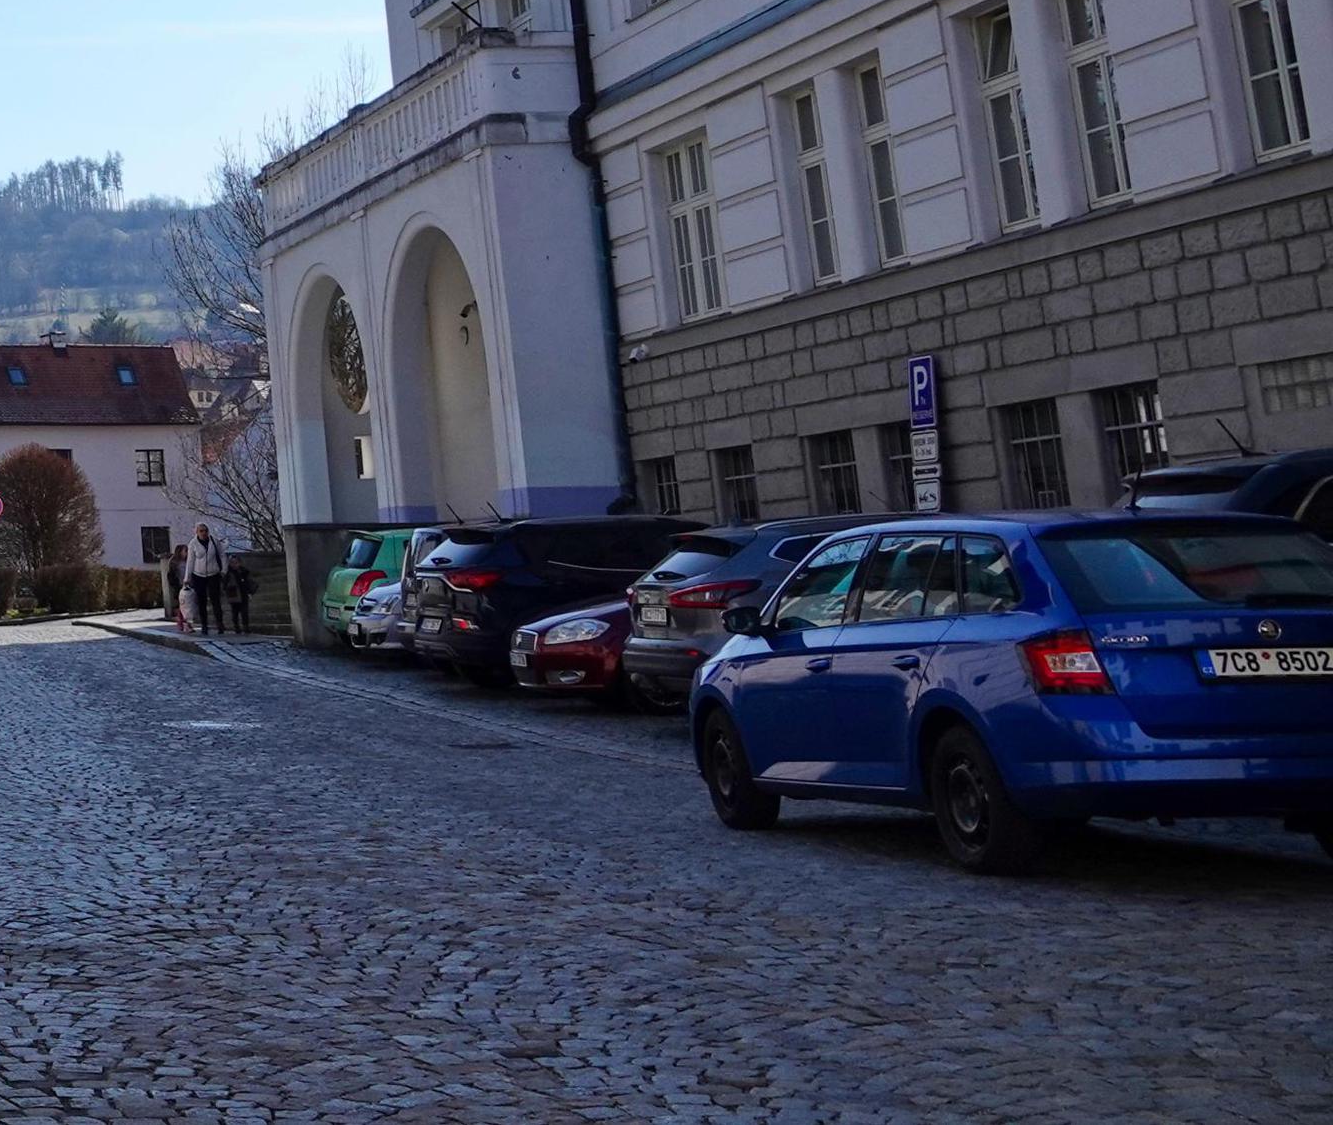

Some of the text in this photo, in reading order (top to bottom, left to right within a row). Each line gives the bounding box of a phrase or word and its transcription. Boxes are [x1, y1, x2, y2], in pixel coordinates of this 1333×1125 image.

[913, 366, 927, 405] P
[1215, 651, 1333, 672] 7C8 8502
